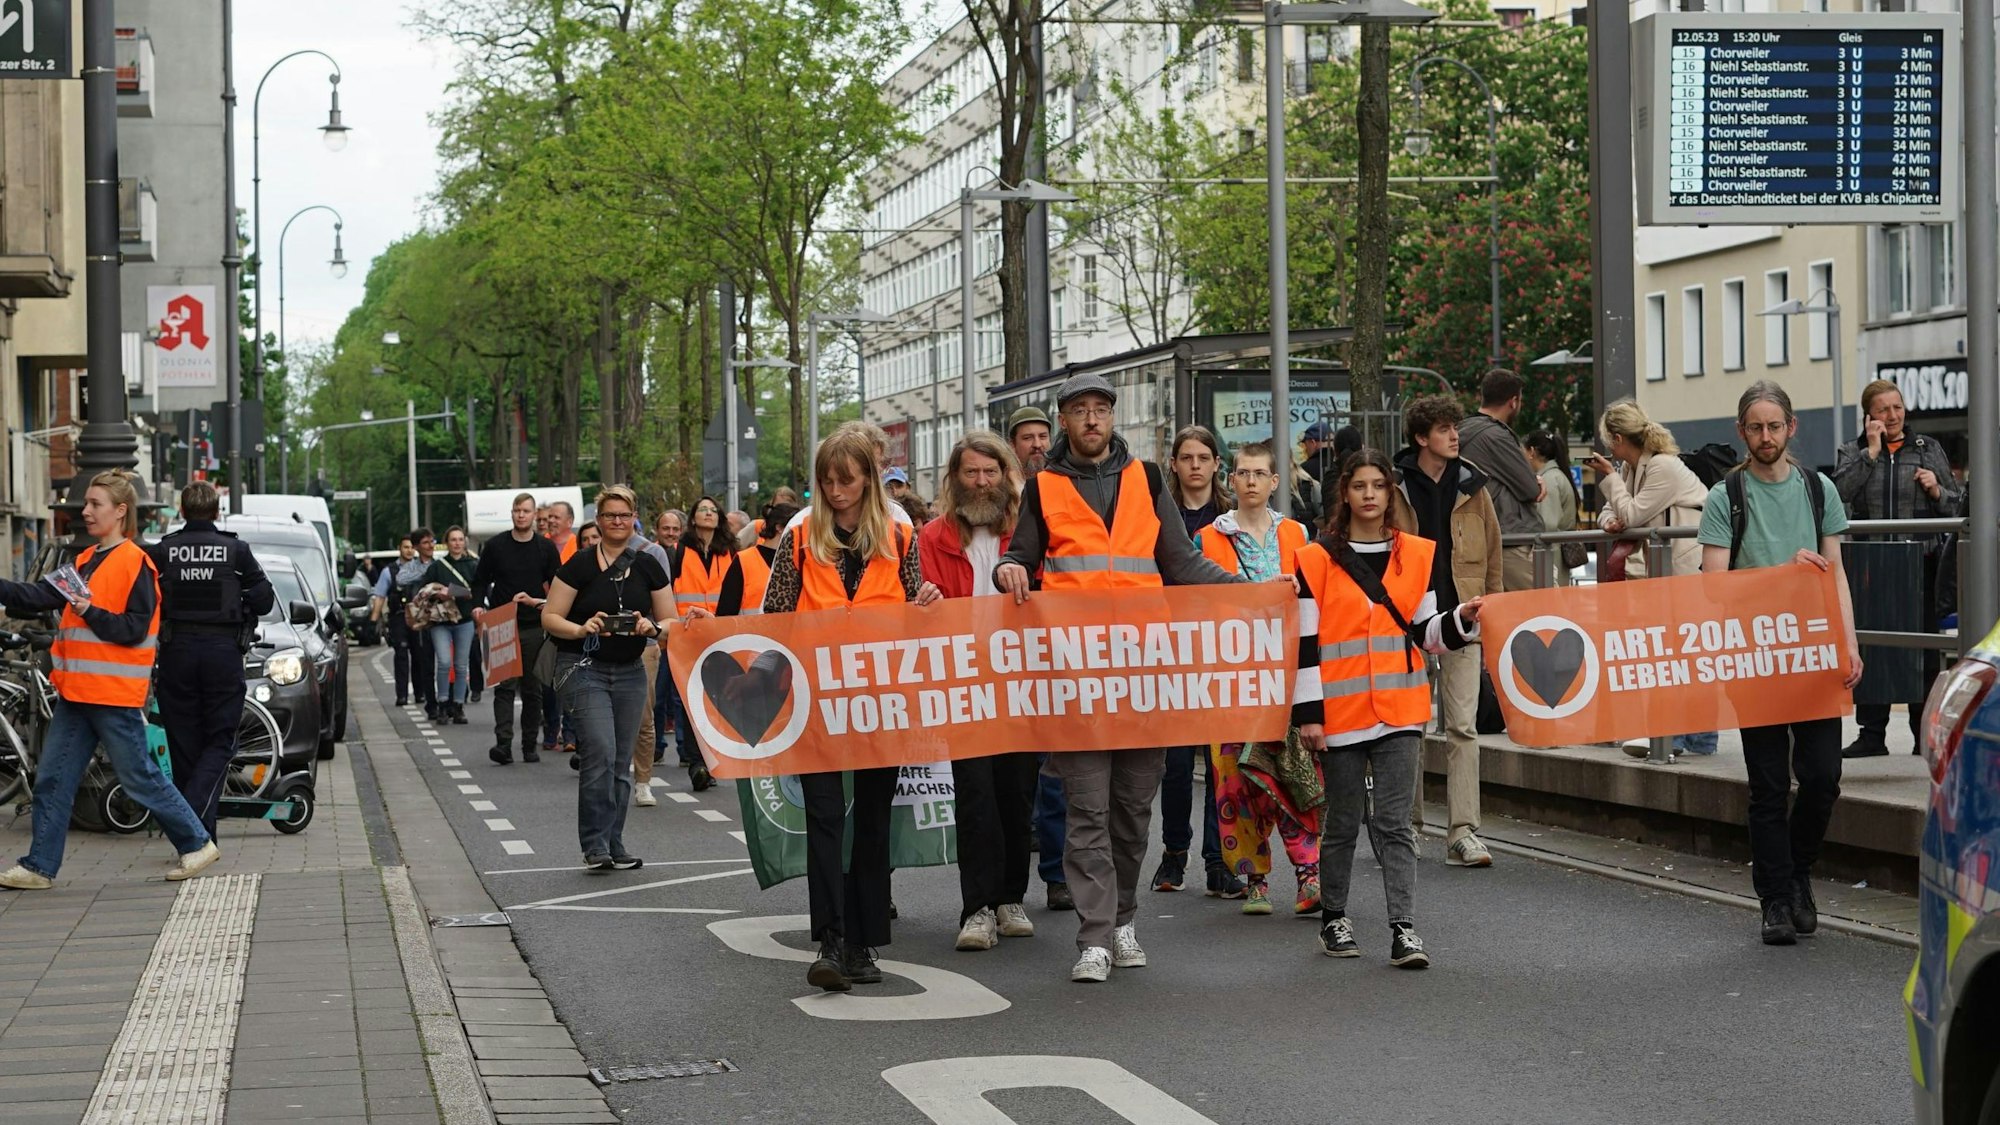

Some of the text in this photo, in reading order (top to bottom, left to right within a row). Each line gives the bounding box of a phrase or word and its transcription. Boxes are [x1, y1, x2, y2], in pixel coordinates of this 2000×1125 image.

[1677, 32, 1932, 42] 12.05.23 15:20 Uhr Gleis in
[1682, 48, 1932, 59] 15 Chorweiler 3 U 3 Min
[0, 59, 55, 70] zer Str. 2
[1682, 61, 1932, 72] 16 Niehl Sebastianstr. 3 U 4 Min
[1682, 74, 1932, 85] 15 Chorweiler 3 U 12 Min
[1682, 88, 1932, 99] 16 Niehl Sebastianstr. 3 U 14 Min
[1682, 101, 1932, 112] 15 Chorweiler 3 U 22 Min
[1681, 114, 1931, 125] 16 Niehl Sebastianstr. 3 U 24 Min
[1681, 127, 1931, 138] 15 Chorweiler 3 U 32 Min
[1681, 141, 1931, 152] 16 Niehl Sebastianstr. 3 U 34 Min
[1680, 154, 1930, 165] 15 Chorweiler 3 U 42 Min
[1680, 167, 1930, 178] 16 Niehl Sebastianstr. 3 U 44 Min
[1680, 180, 1930, 191] 15 Chorweiler 3 U 52 Min
[1679, 193, 1698, 204] das
[1701, 193, 1798, 204] Deutschlandticket
[1800, 193, 1818, 204] bei
[1820, 193, 1838, 204] der
[1840, 193, 1862, 204] KVB
[1864, 193, 1880, 204] als
[1882, 193, 1933, 205] Chipkarte
[160, 357, 212, 367] OLONIA
[168, 546, 228, 562] POLIZEI
[180, 568, 214, 580] NRW
[1604, 626, 1674, 662] ART.
[1678, 618, 1748, 654] 20A
[1752, 612, 1800, 646] GG
[815, 618, 1284, 690] LETZTE GENERATION
[1607, 644, 1838, 692] LEBEN SCHÜTZEN
[818, 670, 1286, 736] VOR DEN KIPPPUNKTEN
